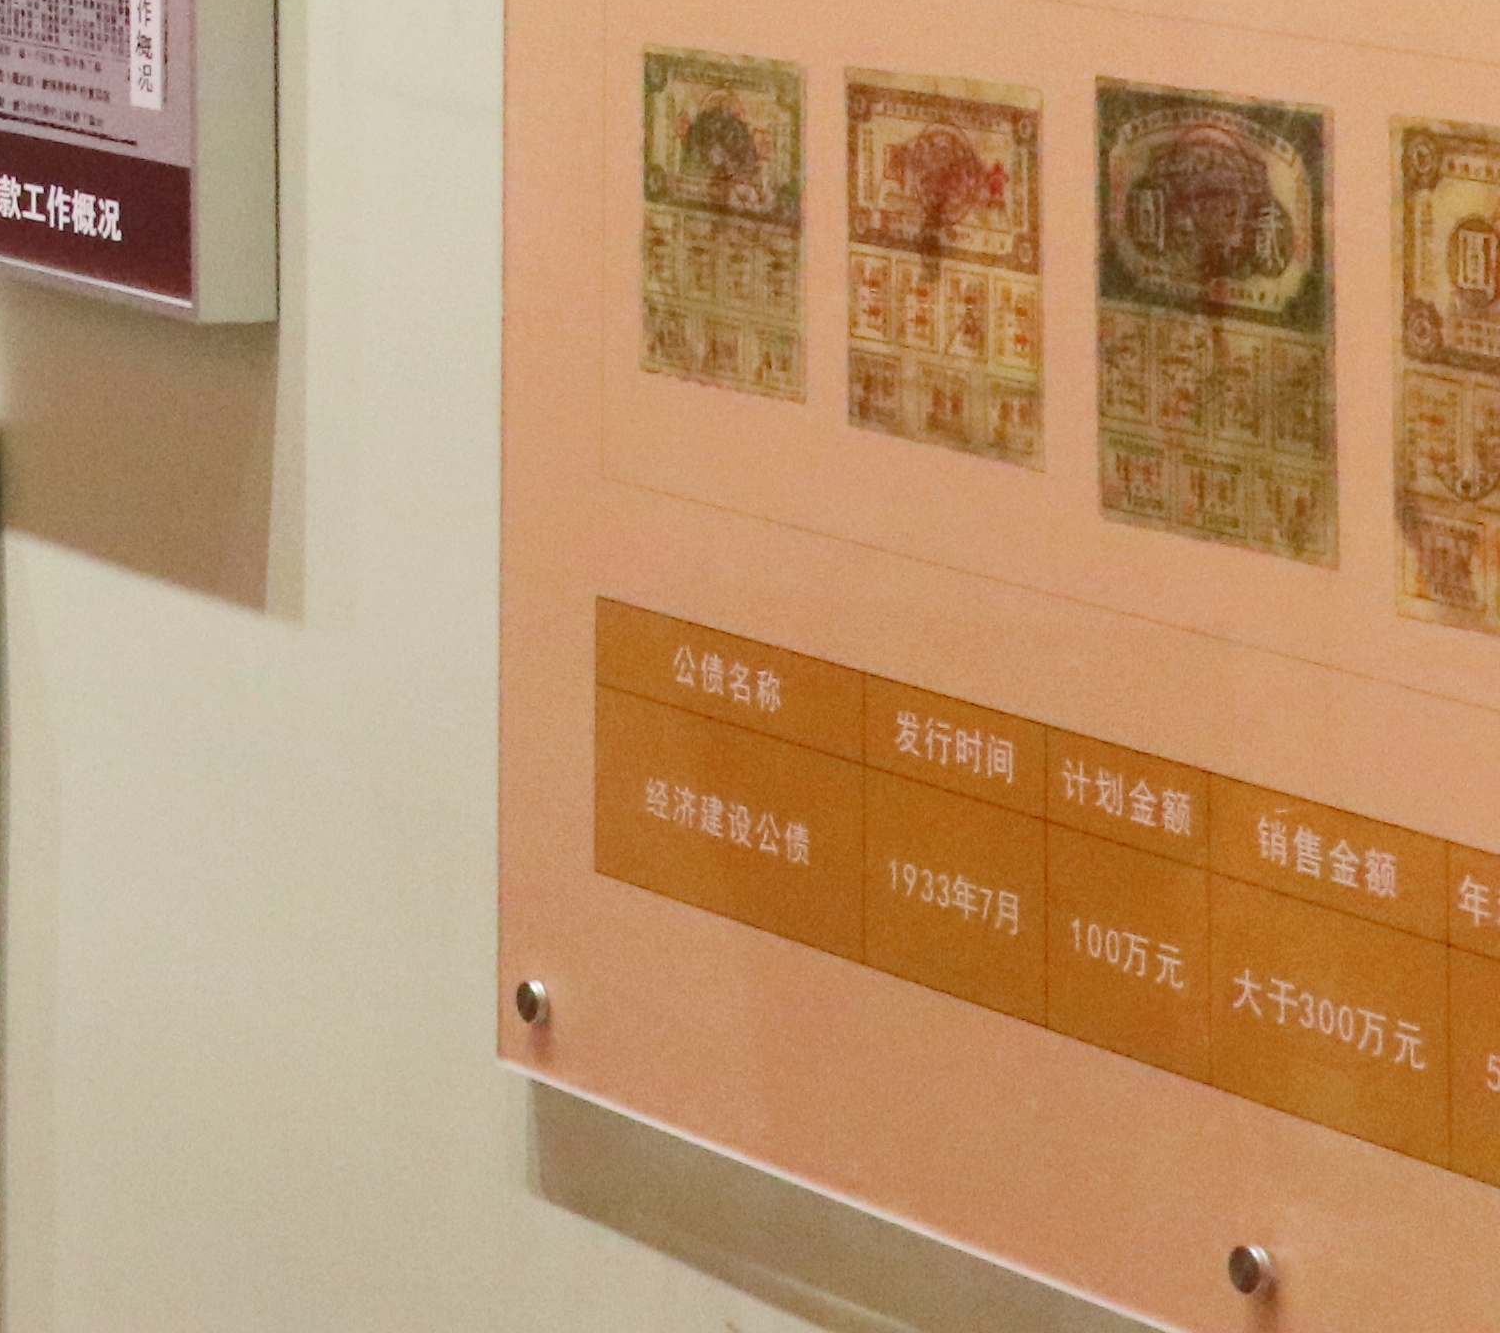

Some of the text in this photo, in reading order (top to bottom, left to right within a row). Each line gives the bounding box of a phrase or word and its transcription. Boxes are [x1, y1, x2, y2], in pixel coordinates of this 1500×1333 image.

[673, 645, 781, 713] 公债名称
[895, 711, 1016, 783] 发行时间
[646, 778, 811, 867] 经济建设公债
[1062, 760, 1193, 838] 计划金额
[1258, 816, 1397, 900] 销售金额
[889, 860, 1020, 935] 1933年7月
[1459, 875, 1500, 927] 年
[1070, 917, 1185, 990] 100万元
[1233, 969, 1426, 1072] 大于300万元
